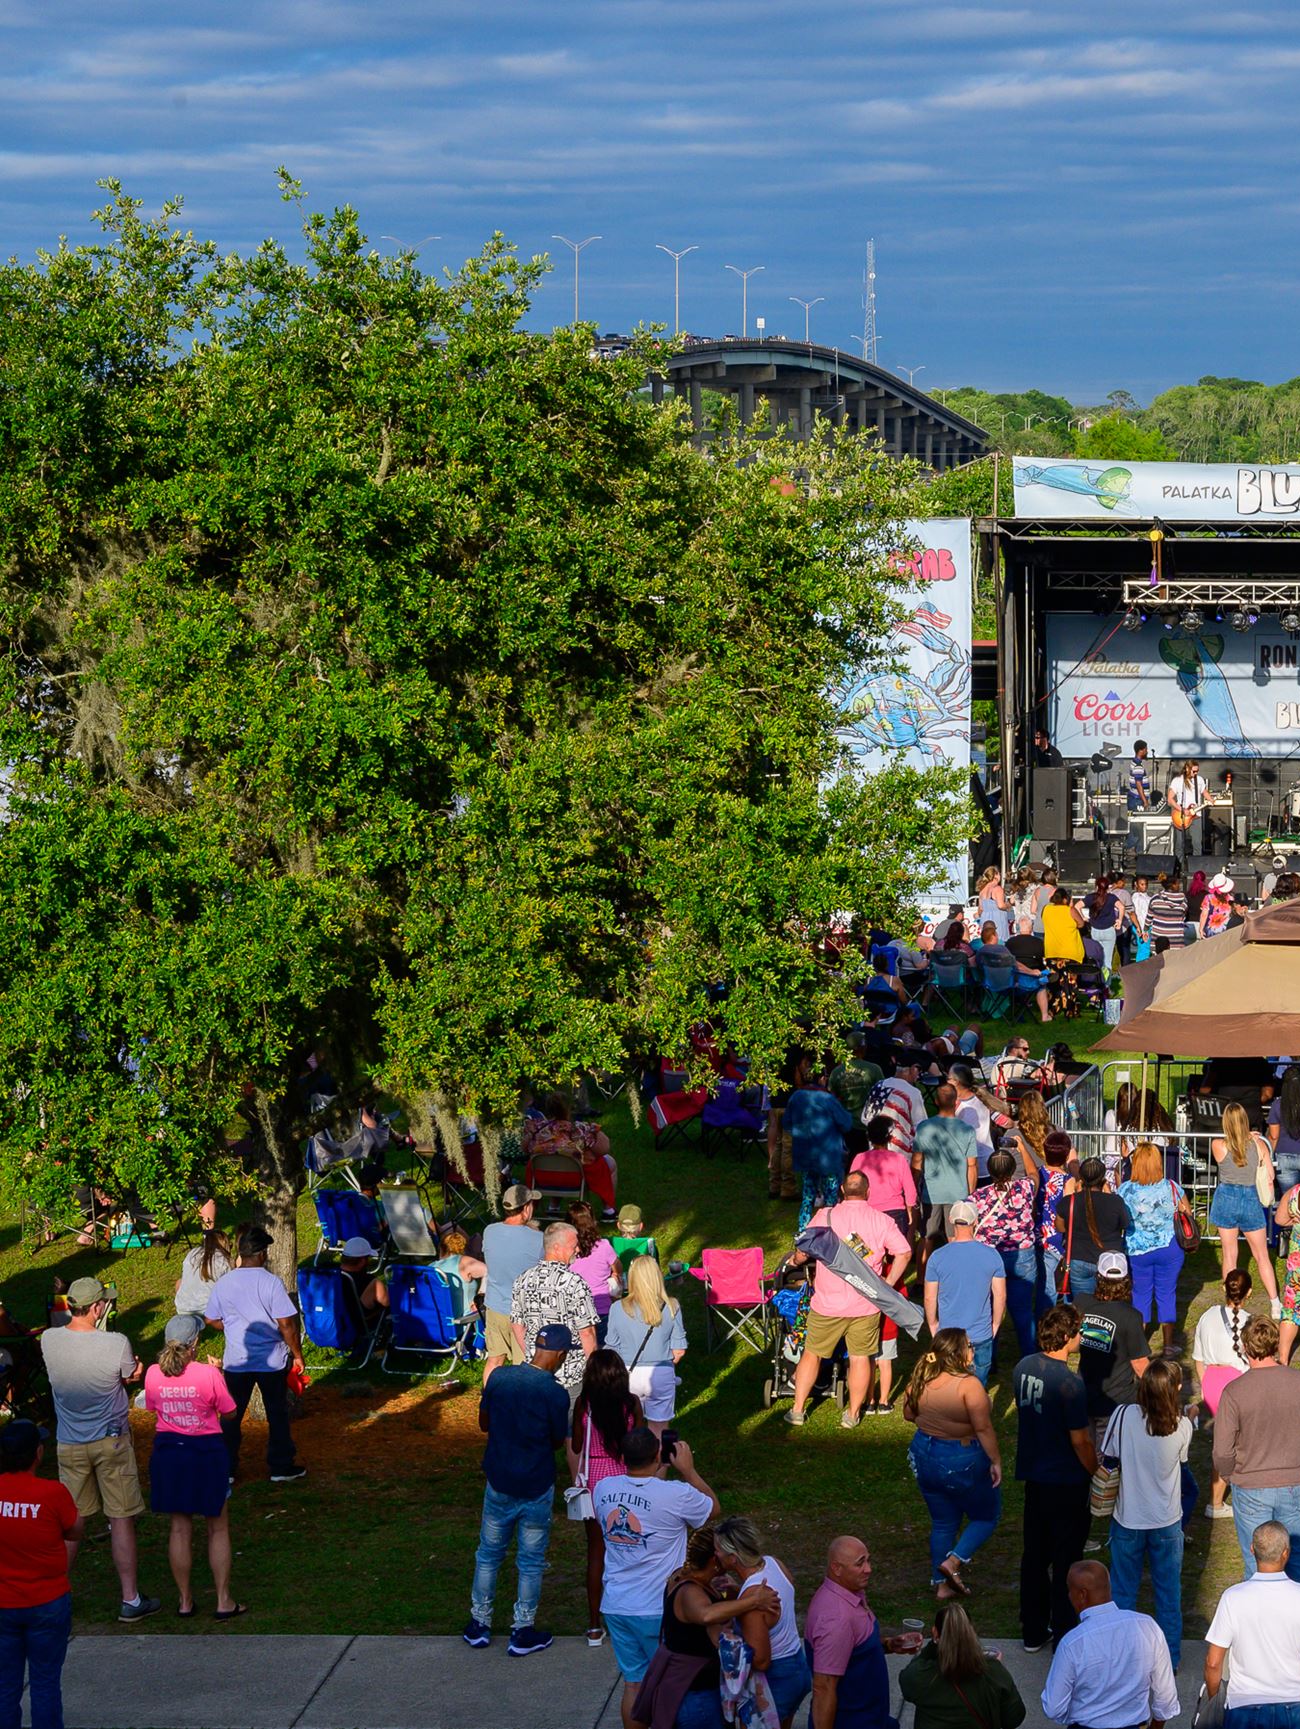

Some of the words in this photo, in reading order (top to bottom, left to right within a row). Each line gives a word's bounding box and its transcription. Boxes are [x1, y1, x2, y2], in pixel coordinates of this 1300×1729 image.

[1162, 485, 1232, 500] PALATKA
[1080, 652, 1140, 676] Palatka
[1260, 645, 1297, 669] RON
[1073, 694, 1152, 721] Coors
[1083, 722, 1143, 736] LIGHT
[1083, 1317, 1113, 1331] AGELLAN
[159, 1386, 200, 1398] JESUS.
[162, 1401, 197, 1413] GUNS.
[601, 1493, 627, 1506] SALT
[628, 1494, 651, 1511] LIFE
